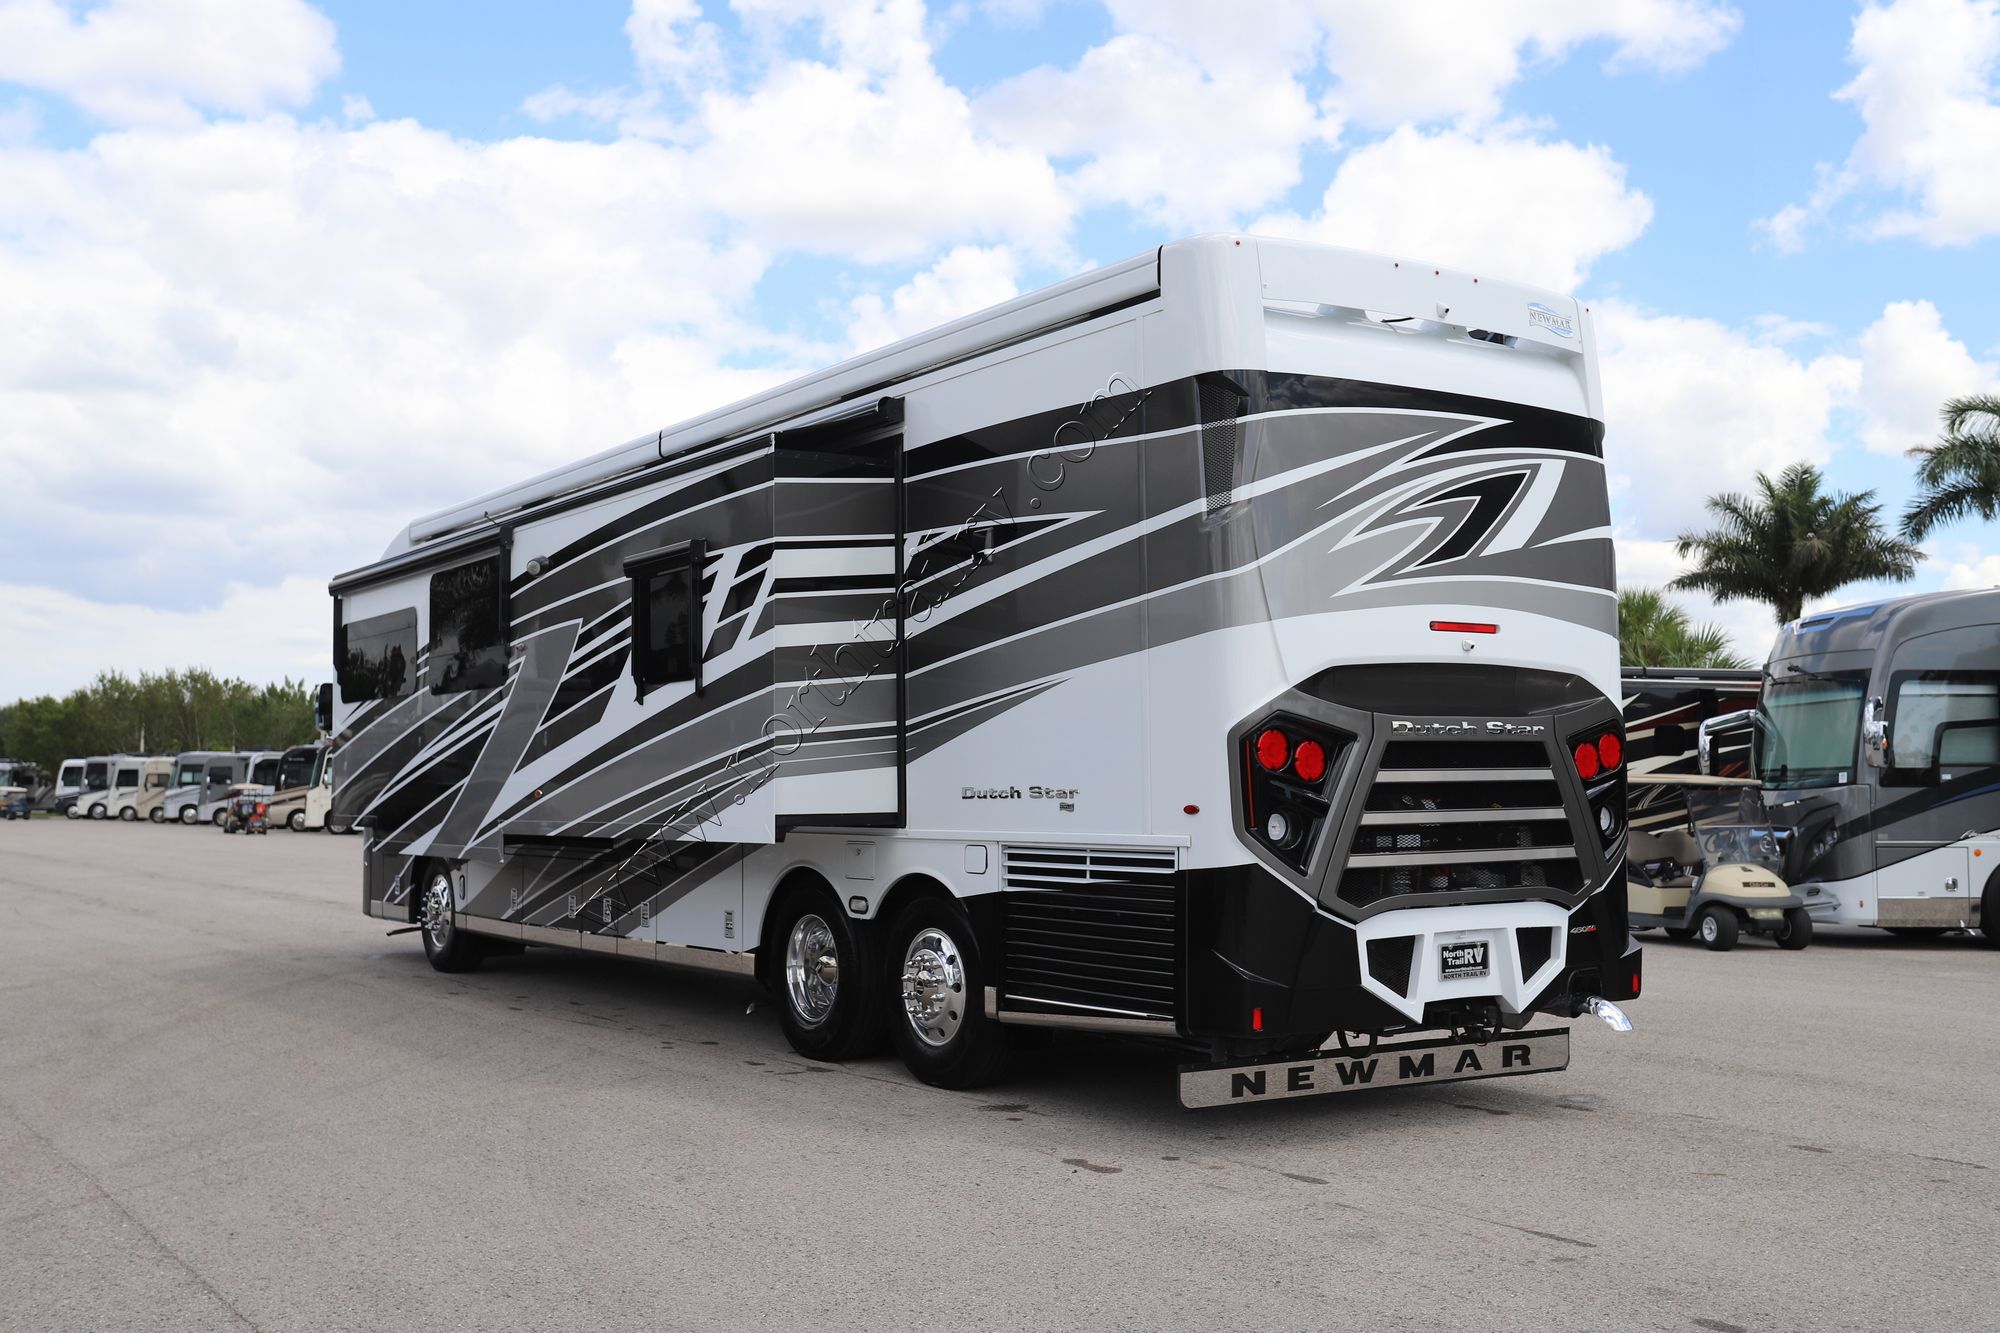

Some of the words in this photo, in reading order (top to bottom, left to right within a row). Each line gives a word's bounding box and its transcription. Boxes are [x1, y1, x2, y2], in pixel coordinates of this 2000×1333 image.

[1529, 311, 1572, 329] NEWMAR
[1391, 720, 1478, 736] Dutch
[1486, 721, 1545, 736] Star
[961, 786, 1022, 800] Dutch
[1028, 786, 1080, 800] Star
[1443, 949, 1464, 958] North
[1447, 957, 1464, 965] Trail
[1464, 947, 1484, 964] RV
[1443, 972, 1462, 980] NORTH
[1231, 1045, 1531, 1098] NEWMAR
